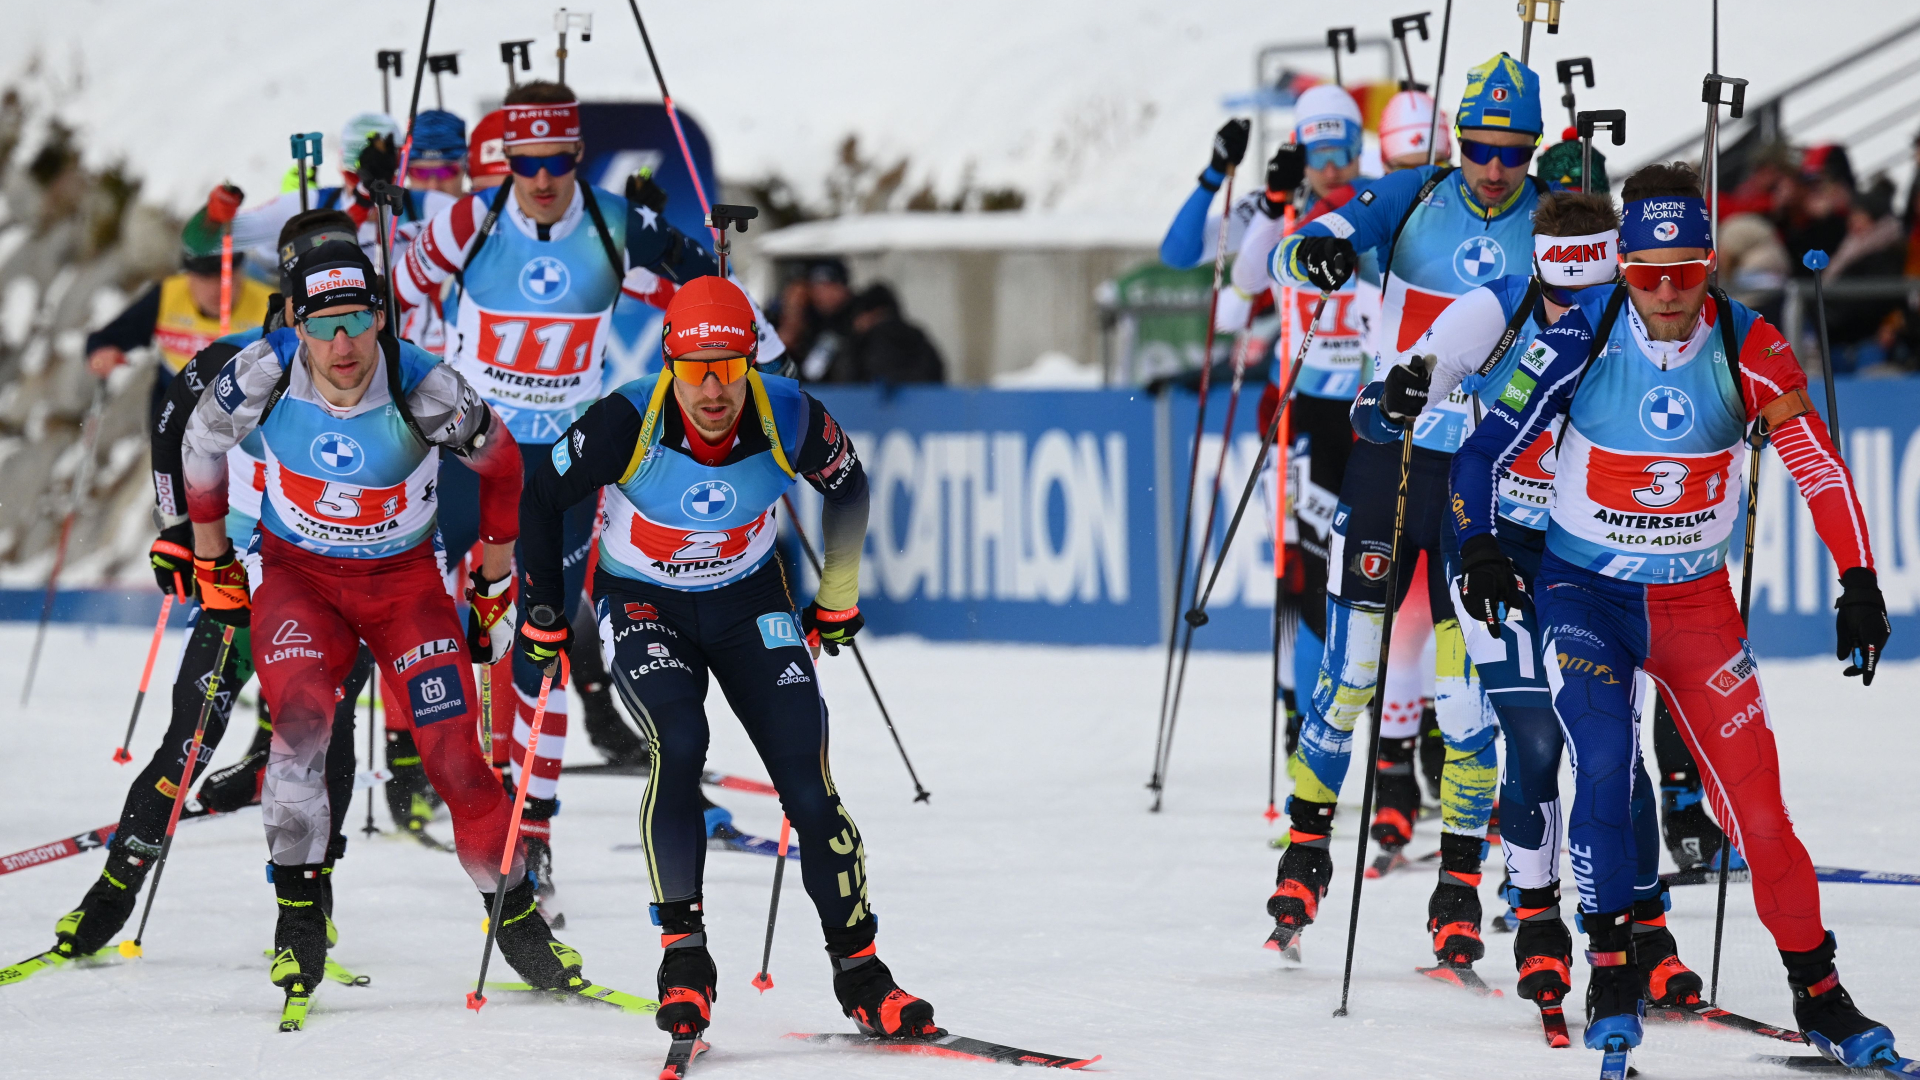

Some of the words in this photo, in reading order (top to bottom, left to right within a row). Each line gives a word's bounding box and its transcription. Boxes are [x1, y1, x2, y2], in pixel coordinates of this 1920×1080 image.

[518, 108, 571, 120] ARIENS
[1641, 211, 1685, 222] AVORIAZ
[1643, 201, 1686, 213] MORZINE
[1541, 241, 1607, 263] AVANT
[307, 279, 366, 297] HASENAUER
[677, 322, 745, 339] VIESSMANN
[1545, 327, 1582, 338] CRAFT
[490, 320, 576, 371] 11
[573, 341, 590, 370] 1
[483, 366, 582, 389] ANTERSELVA
[1490, 405, 1520, 430] LAPUA
[829, 449, 859, 490] tectak
[1631, 459, 1691, 509] 3
[1705, 472, 1721, 502] 1
[314, 481, 363, 519] 5
[382, 495, 398, 517] 1
[802, 428, 1132, 605] ECATHLON
[1593, 508, 1717, 530] ANTERSELVA
[670, 531, 731, 562] 2
[615, 621, 678, 643] WÜRTH
[1559, 624, 1606, 648] Région
[1556, 652, 1621, 685] omfy
[776, 674, 811, 687] adidas
[415, 698, 461, 718] Husqvarna
